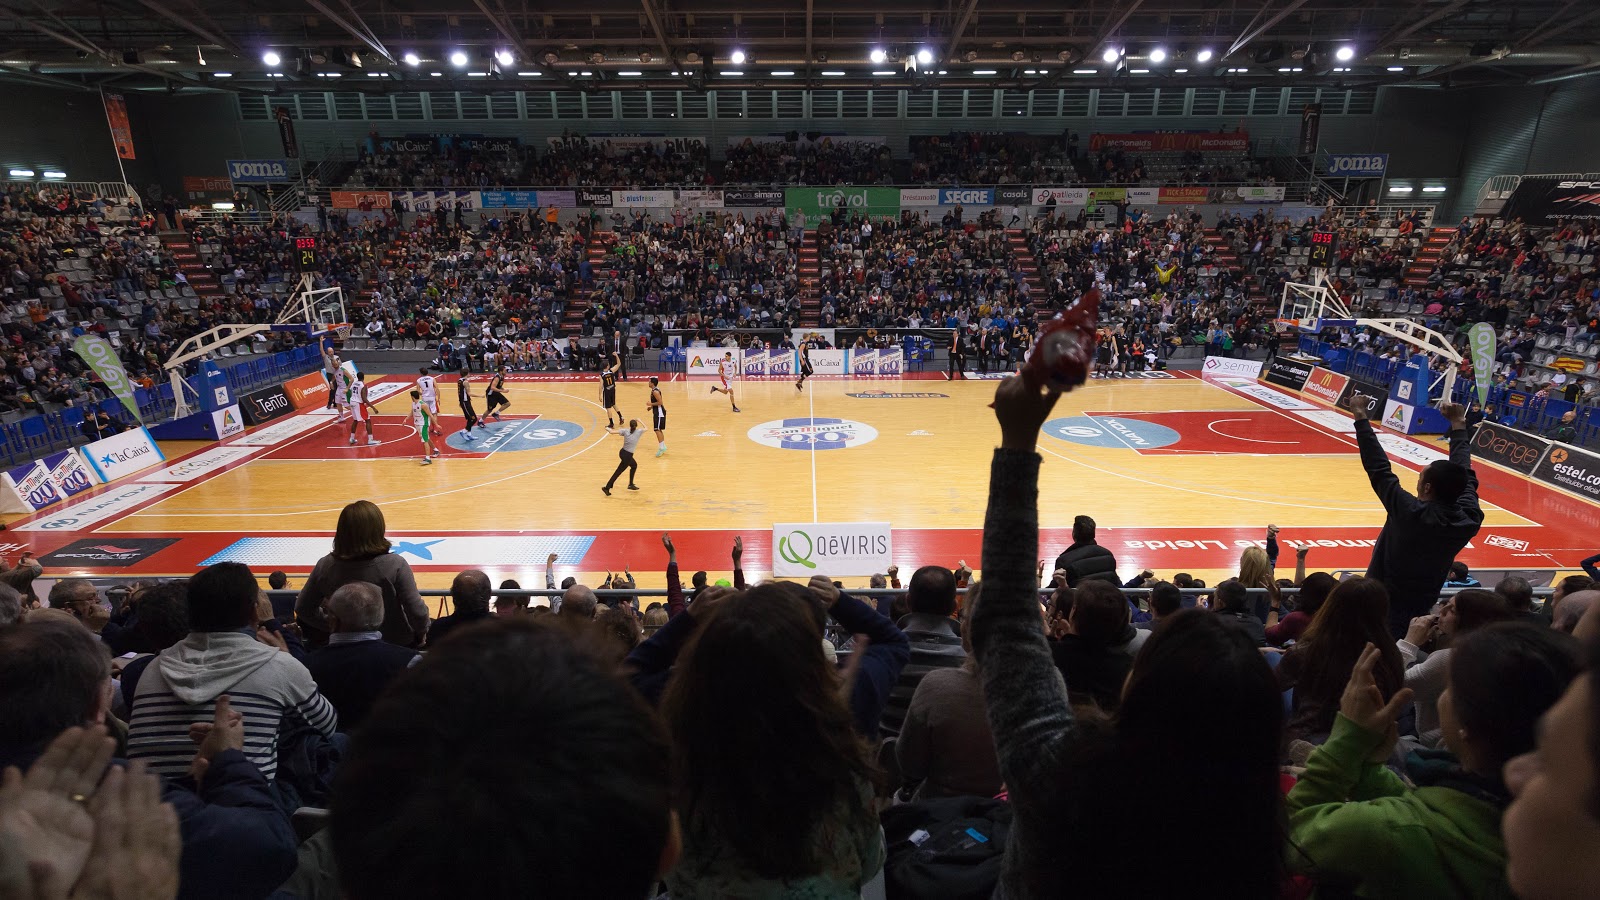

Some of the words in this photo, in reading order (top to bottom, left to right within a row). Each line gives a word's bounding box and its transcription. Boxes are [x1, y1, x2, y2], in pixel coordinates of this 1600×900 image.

[1107, 139, 1152, 147] McDonald's
[1201, 138, 1247, 147] McDonald's
[944, 190, 988, 204] SEGRE
[1002, 189, 1028, 198] casals
[302, 250, 314, 265] 24
[1313, 245, 1327, 259] 24
[1223, 361, 1260, 374] semic
[303, 383, 327, 396] McDonald's
[1305, 380, 1339, 399] McDonald's
[255, 392, 288, 413] Tento
[221, 424, 241, 437] ActelGrup
[1104, 417, 1150, 445] NAVOX
[1384, 418, 1406, 431] ActelGrup
[477, 421, 524, 449] NAVOX
[1477, 428, 1539, 464] Orange
[1553, 473, 1585, 489] Distribuidor
[1122, 538, 1228, 551] Lleida
